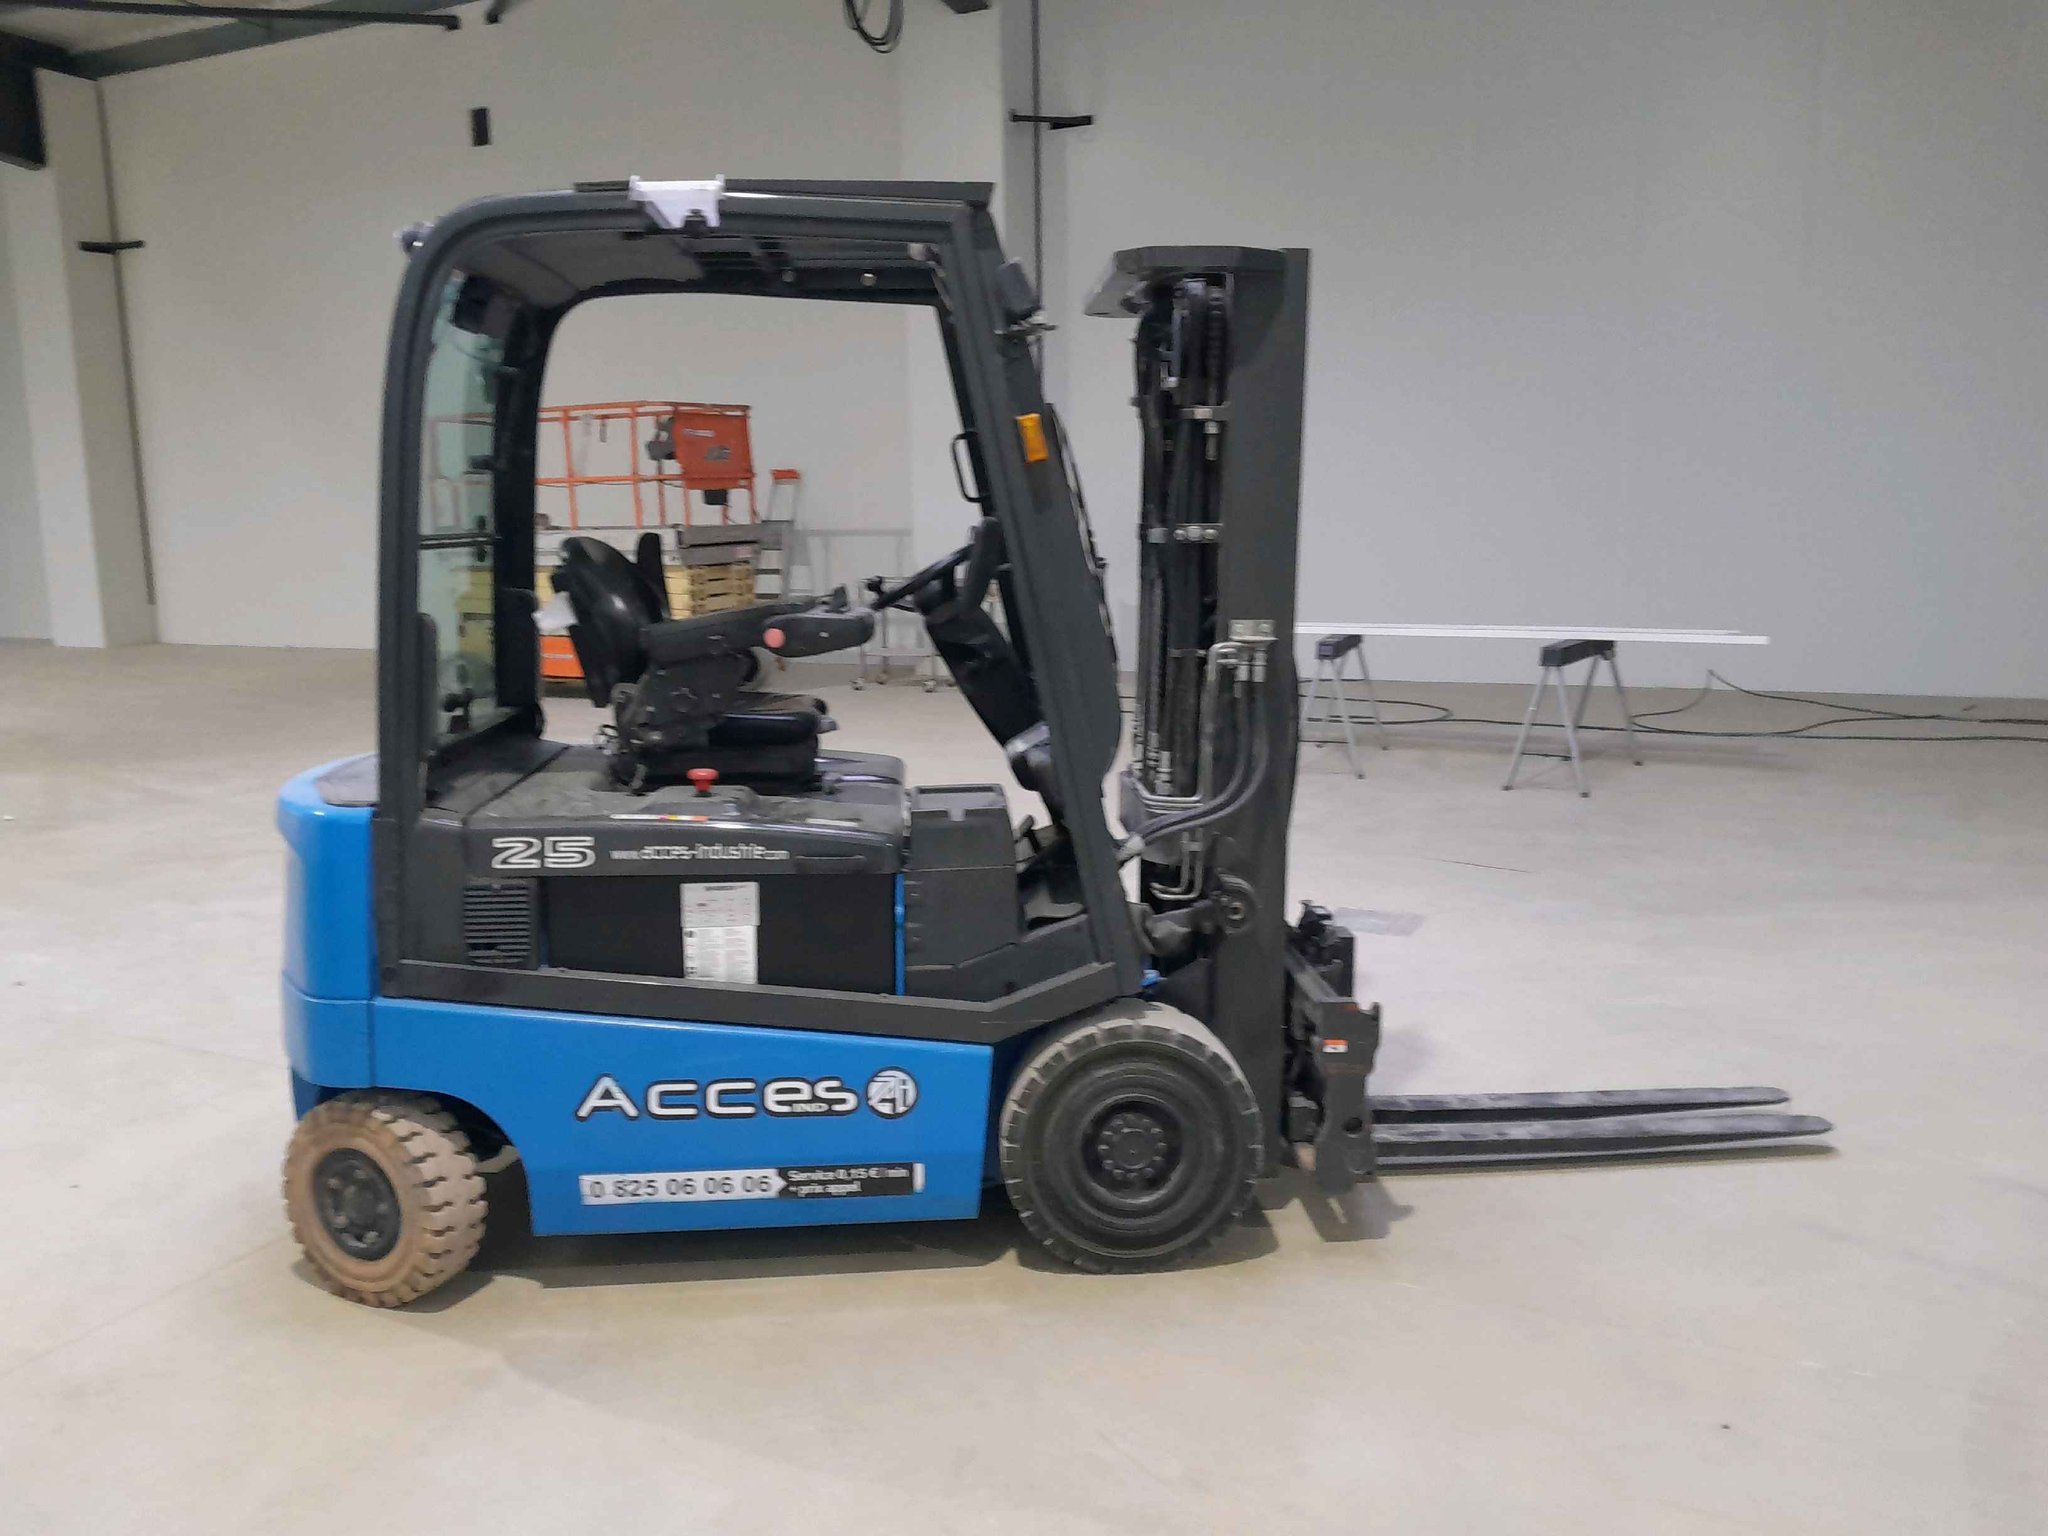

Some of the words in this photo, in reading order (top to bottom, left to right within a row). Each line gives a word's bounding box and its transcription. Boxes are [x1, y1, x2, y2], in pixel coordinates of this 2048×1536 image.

[491, 836, 596, 869] 25
[590, 1181, 605, 1198] 0
[612, 1179, 659, 1197] 825
[666, 1177, 697, 1196] 06
[703, 1176, 735, 1195] 06
[741, 1175, 773, 1193] 06
